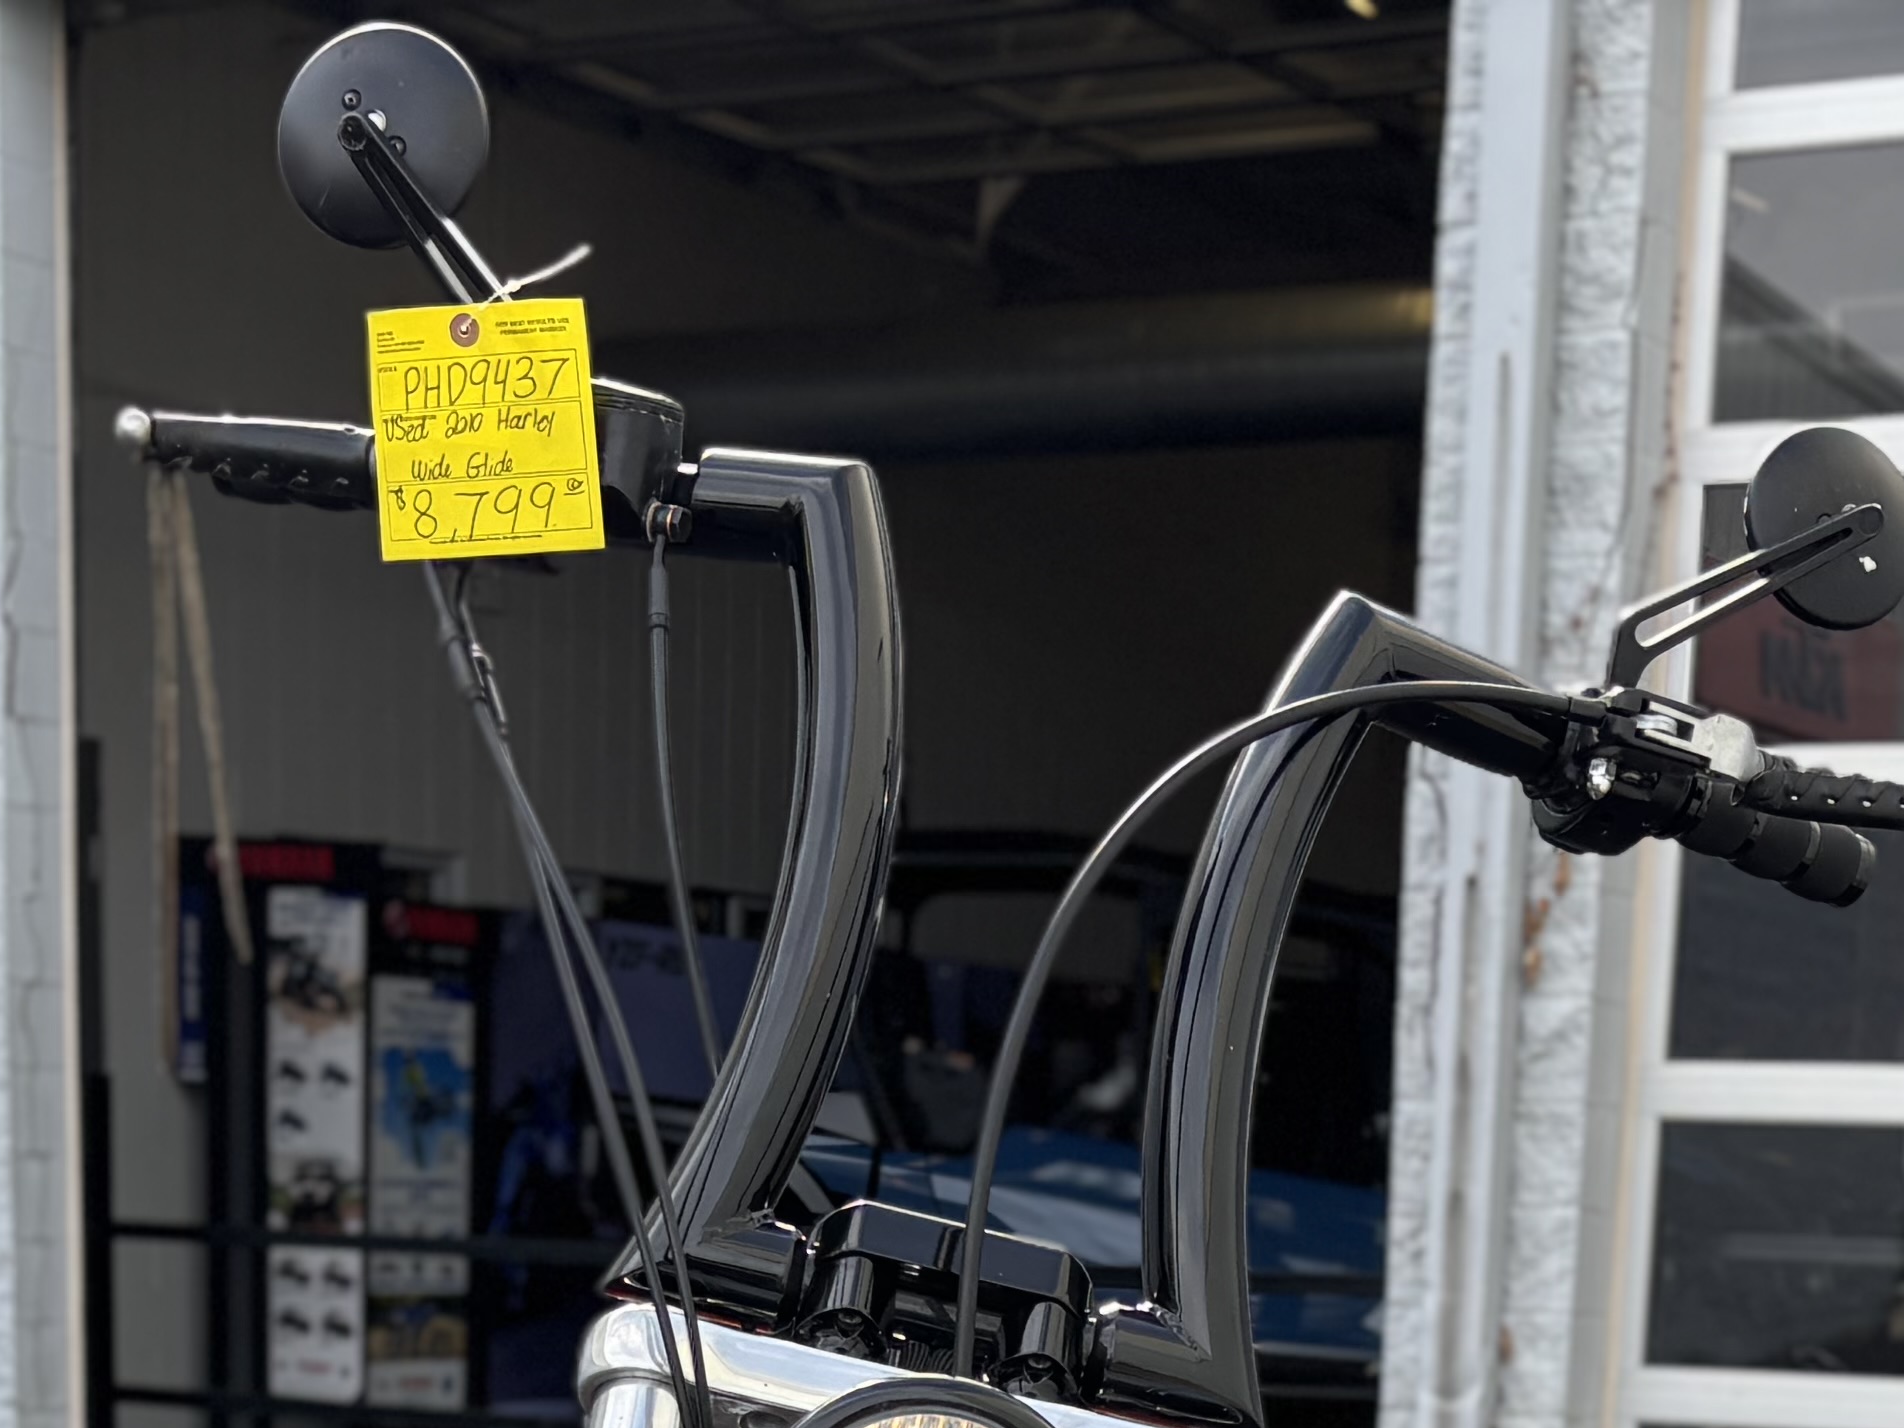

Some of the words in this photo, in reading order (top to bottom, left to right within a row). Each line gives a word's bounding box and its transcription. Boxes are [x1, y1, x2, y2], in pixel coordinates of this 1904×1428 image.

[404, 356, 570, 413] PHD9437
[445, 410, 483, 440] 2010
[497, 405, 556, 437] Harley
[466, 450, 513, 479] Glide
